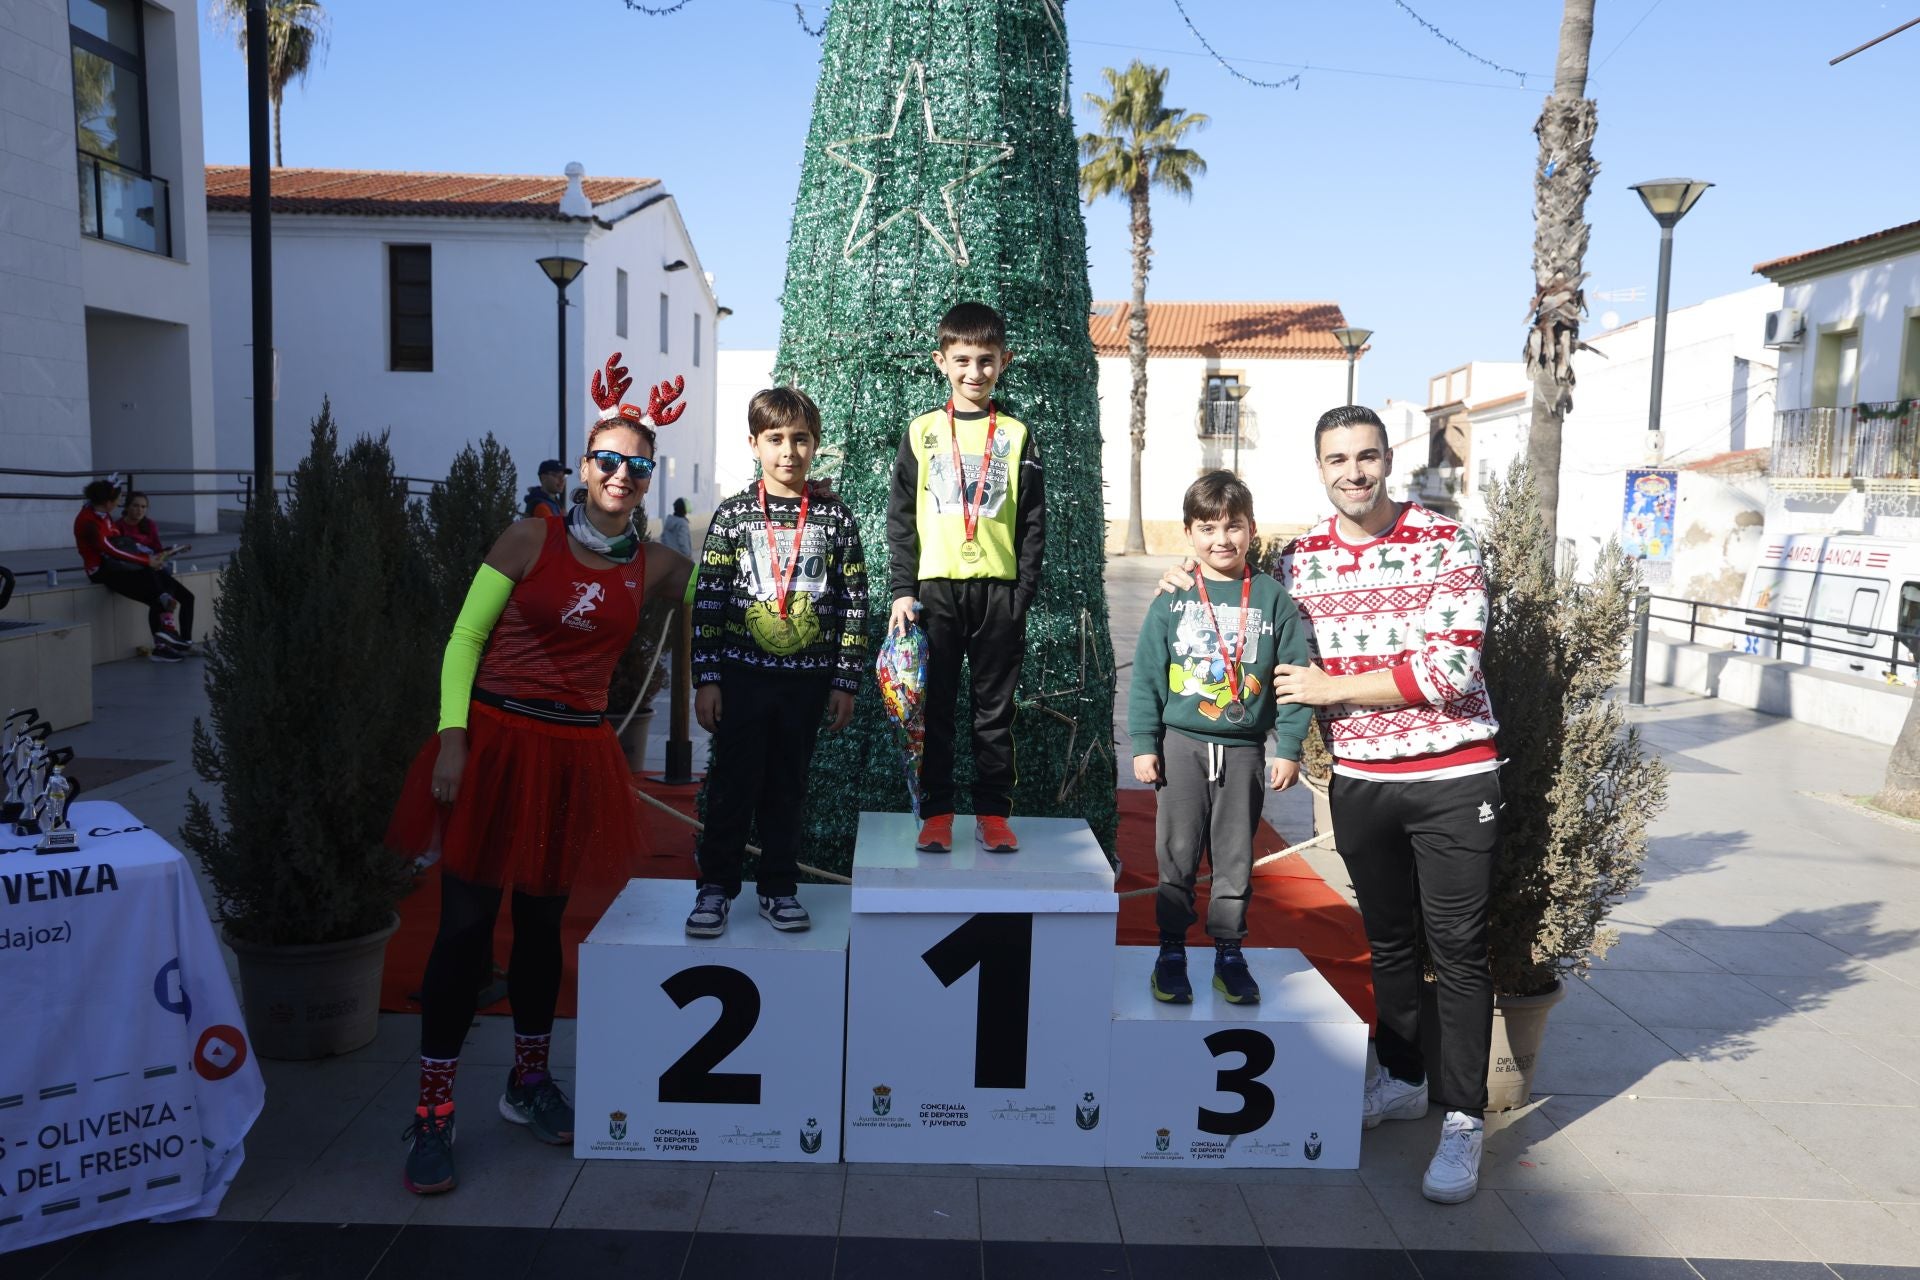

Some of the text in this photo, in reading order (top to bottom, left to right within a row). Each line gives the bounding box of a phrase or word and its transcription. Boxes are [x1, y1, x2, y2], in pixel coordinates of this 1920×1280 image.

[1786, 545, 1862, 567] AMBULANCIA
[0, 863, 118, 905] VENZA
[921, 913, 1033, 1090] 1
[658, 965, 762, 1105] 2
[1198, 1028, 1276, 1136] 3
[38, 1101, 176, 1150] OLIVENZA
[920, 1102, 966, 1112] CONCEJALÍA
[654, 1127, 697, 1137] CONCEJALÍA
[17, 1160, 70, 1193] DEL
[79, 1134, 185, 1179] FRESNO
